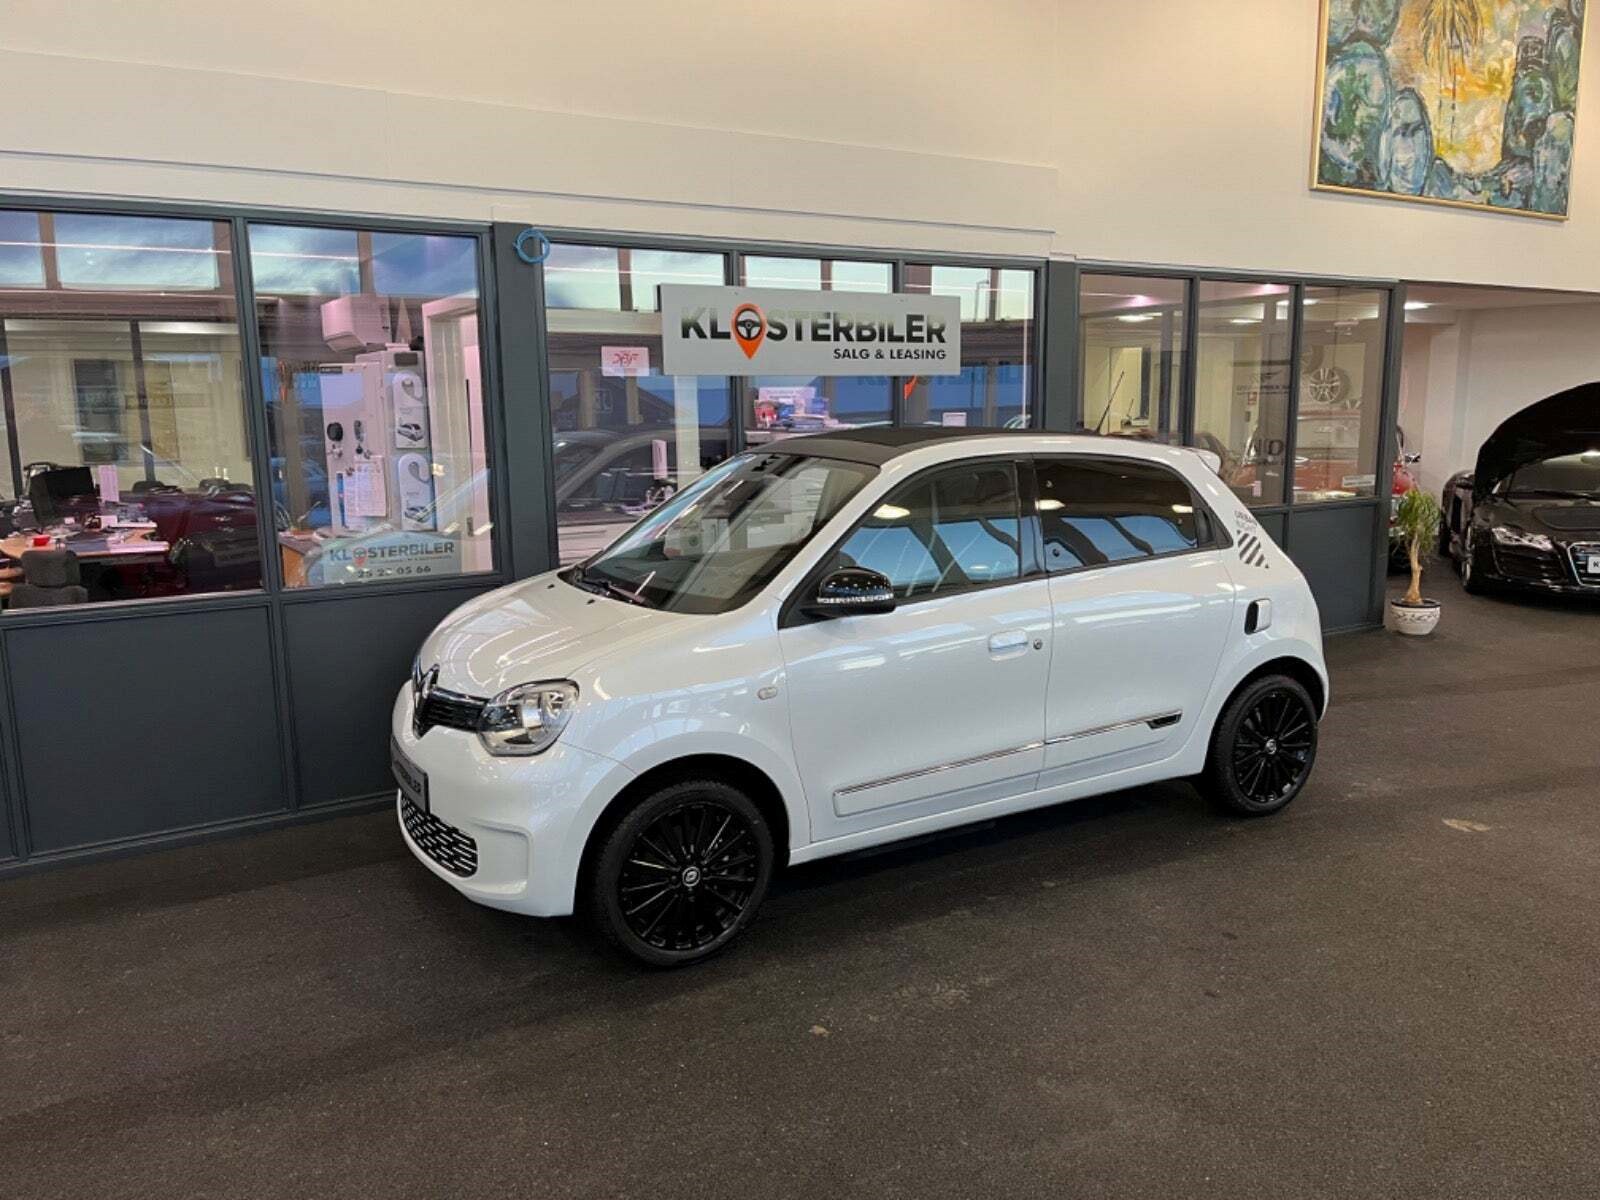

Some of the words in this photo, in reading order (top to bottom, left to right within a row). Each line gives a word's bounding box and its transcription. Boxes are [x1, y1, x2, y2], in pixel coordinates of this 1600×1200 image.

[681, 304, 947, 344] KLOSTERBILER
[833, 348, 870, 360] SALG
[874, 349, 884, 360] &
[889, 349, 947, 360] LEASING
[330, 541, 455, 562] KLOSTERBILER
